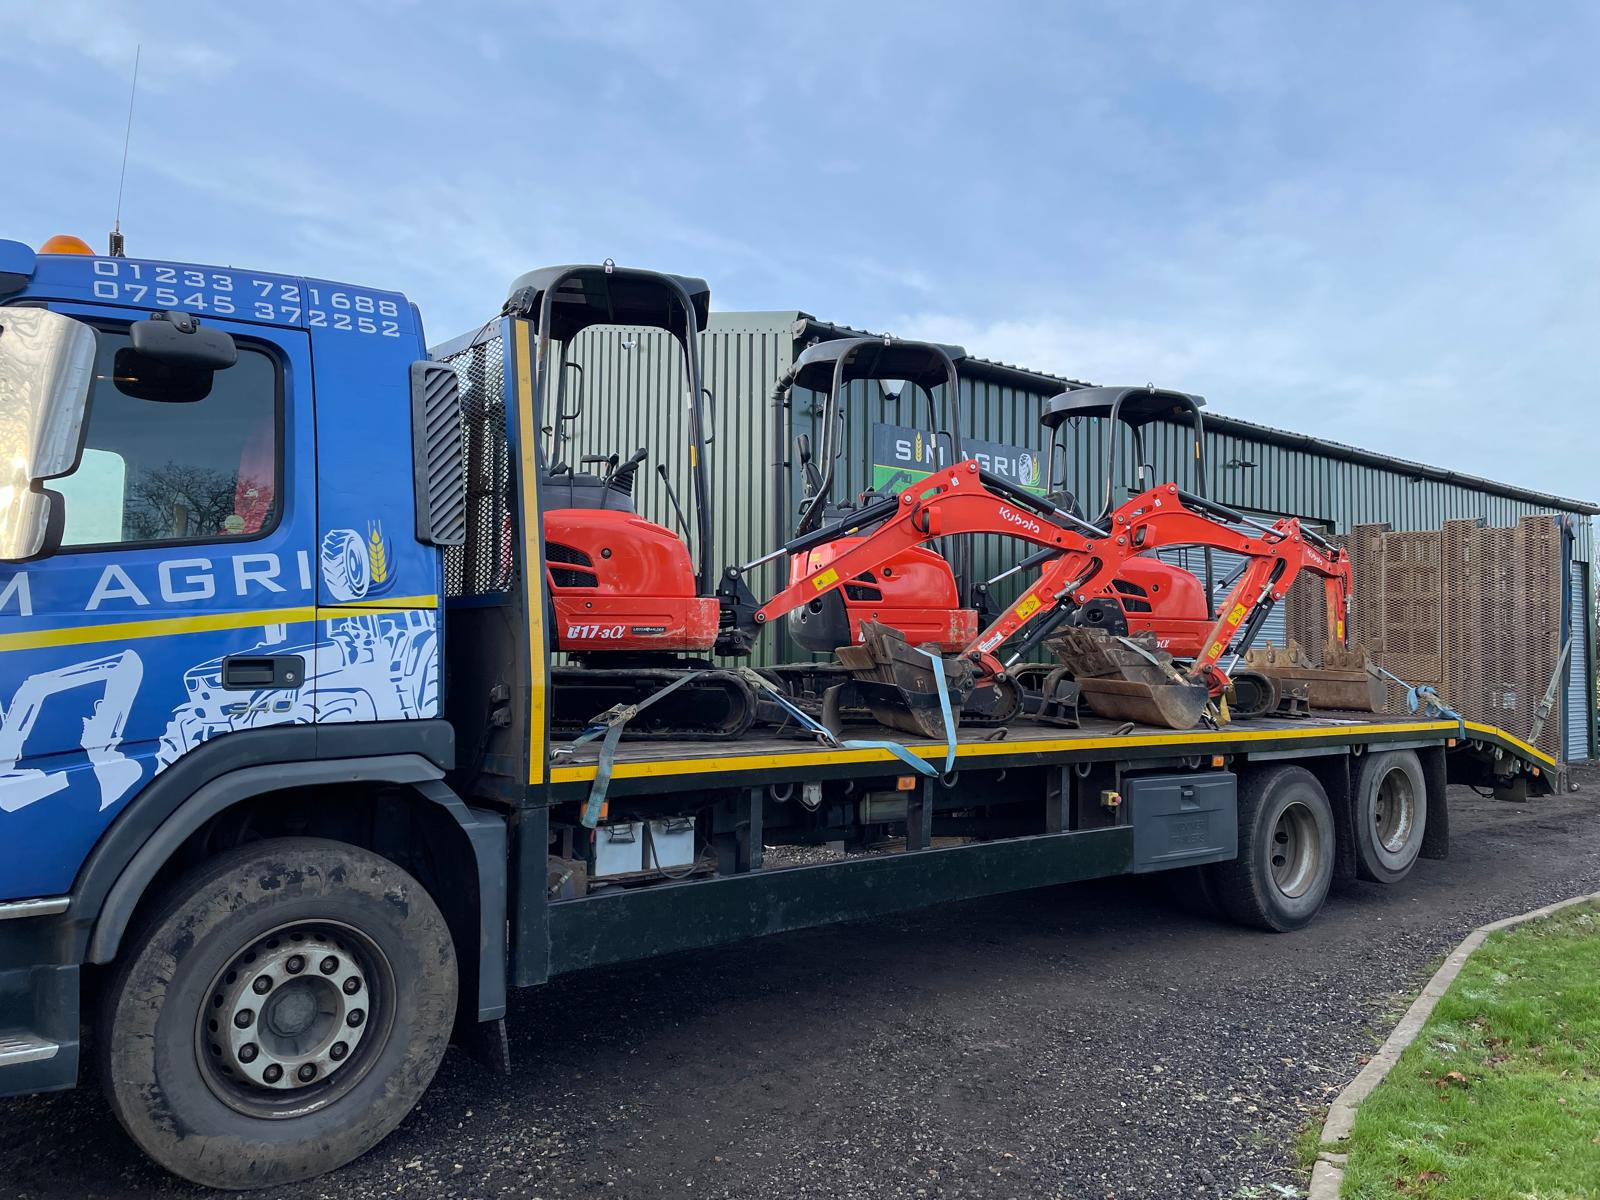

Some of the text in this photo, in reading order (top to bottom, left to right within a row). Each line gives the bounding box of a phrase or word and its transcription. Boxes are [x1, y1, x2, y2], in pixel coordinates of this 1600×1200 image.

[93, 260, 398, 317] 01233 721688
[93, 280, 400, 338] 07545 372252
[999, 506, 1041, 534] Kubota
[85, 550, 312, 611] AGRI
[229, 699, 293, 715] 340
